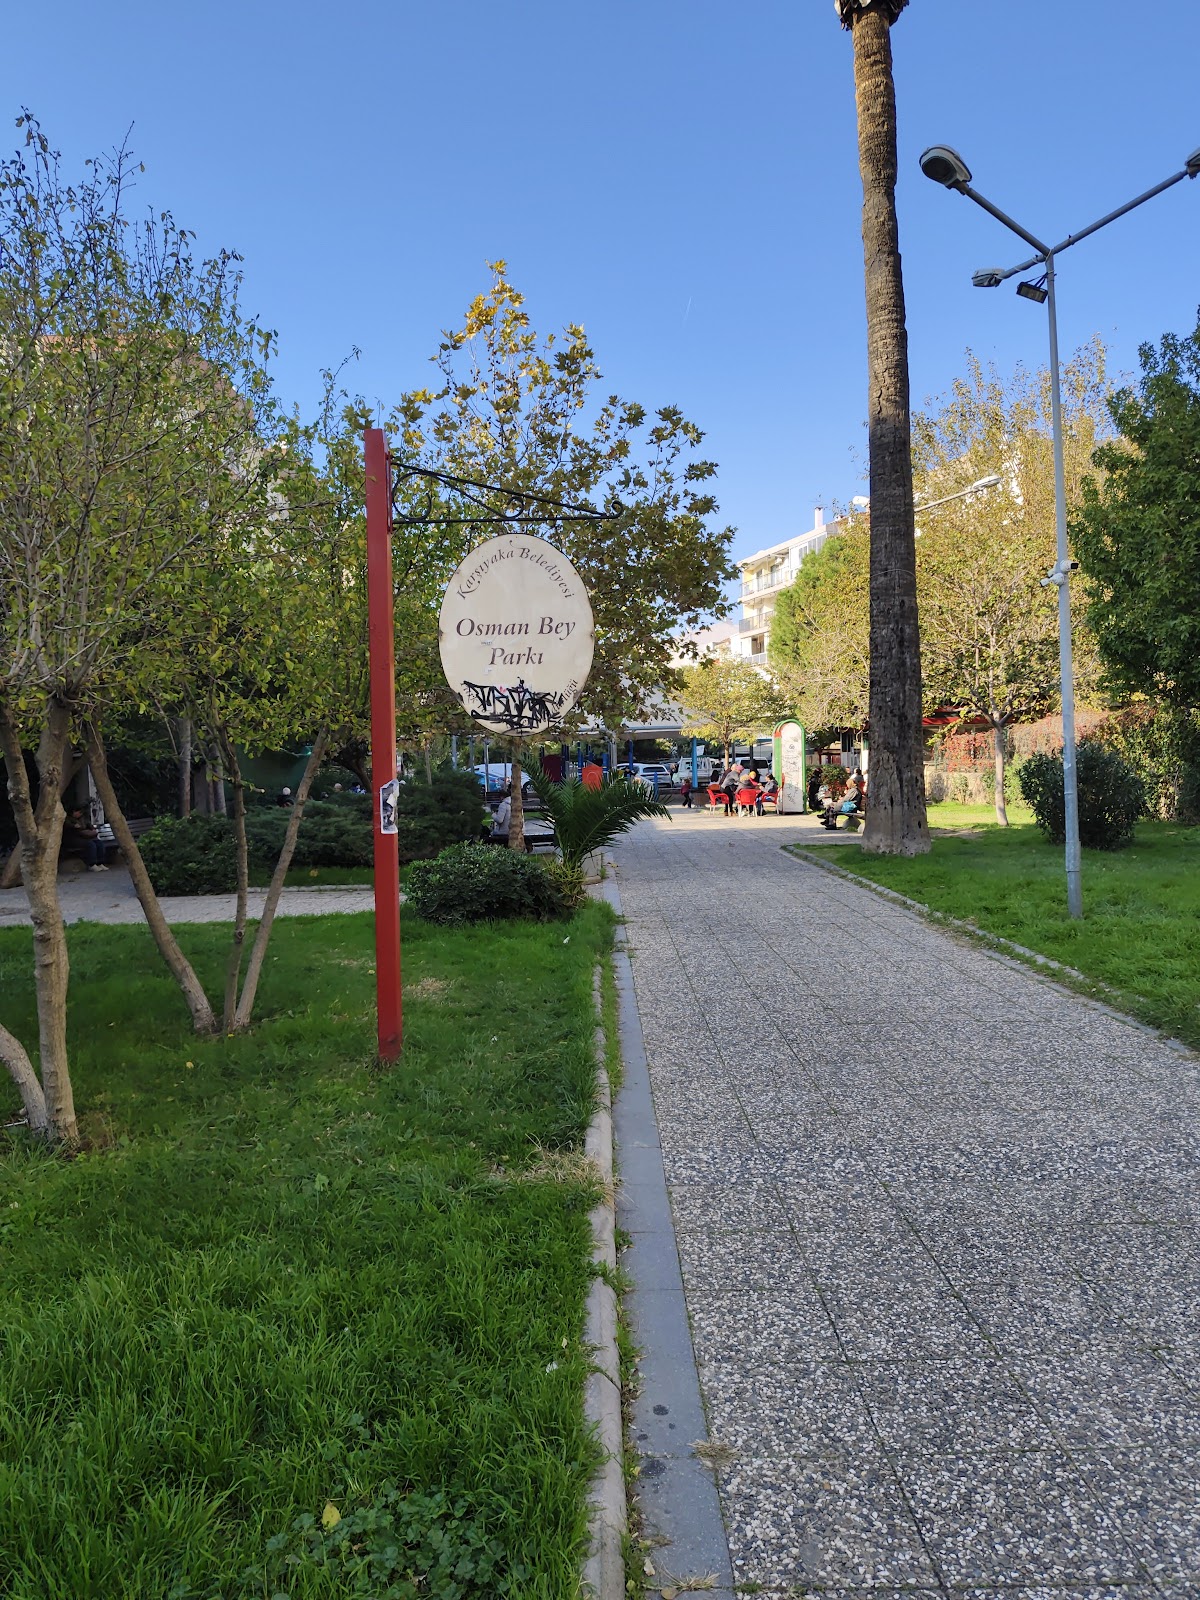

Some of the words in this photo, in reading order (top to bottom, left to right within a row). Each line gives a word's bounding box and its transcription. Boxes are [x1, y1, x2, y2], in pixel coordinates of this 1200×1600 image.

[456, 548, 514, 600] Karşıyaka
[509, 540, 575, 599] Belediyesi
[456, 617, 530, 637] Osman
[537, 616, 576, 641] Bey
[488, 646, 544, 666] Parkı
